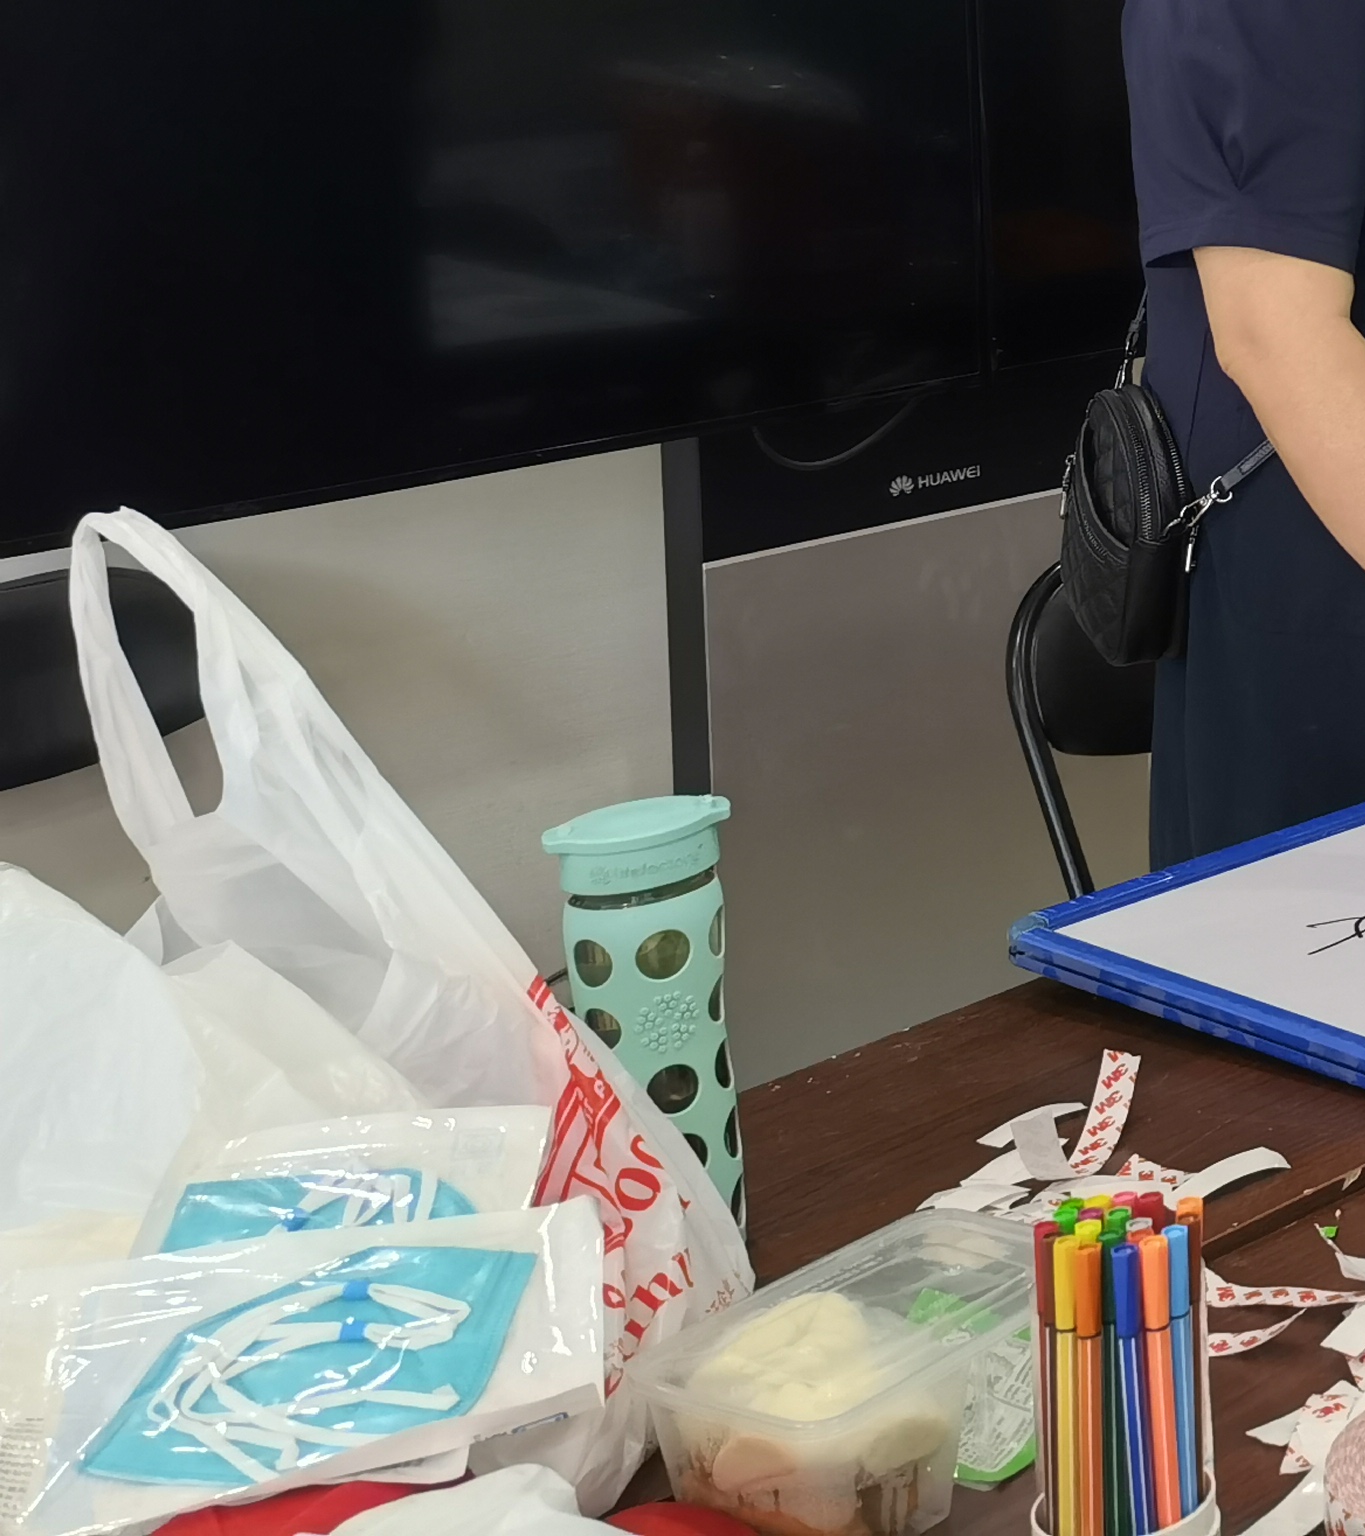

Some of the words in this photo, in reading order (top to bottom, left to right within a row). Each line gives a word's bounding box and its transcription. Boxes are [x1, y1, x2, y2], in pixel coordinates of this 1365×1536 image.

[918, 465, 981, 488] HUAWEI
[1102, 1063, 1128, 1089] 3M
[1095, 1090, 1123, 1115] 3M
[1087, 1116, 1116, 1137] 3M
[1078, 1138, 1108, 1156] 3M
